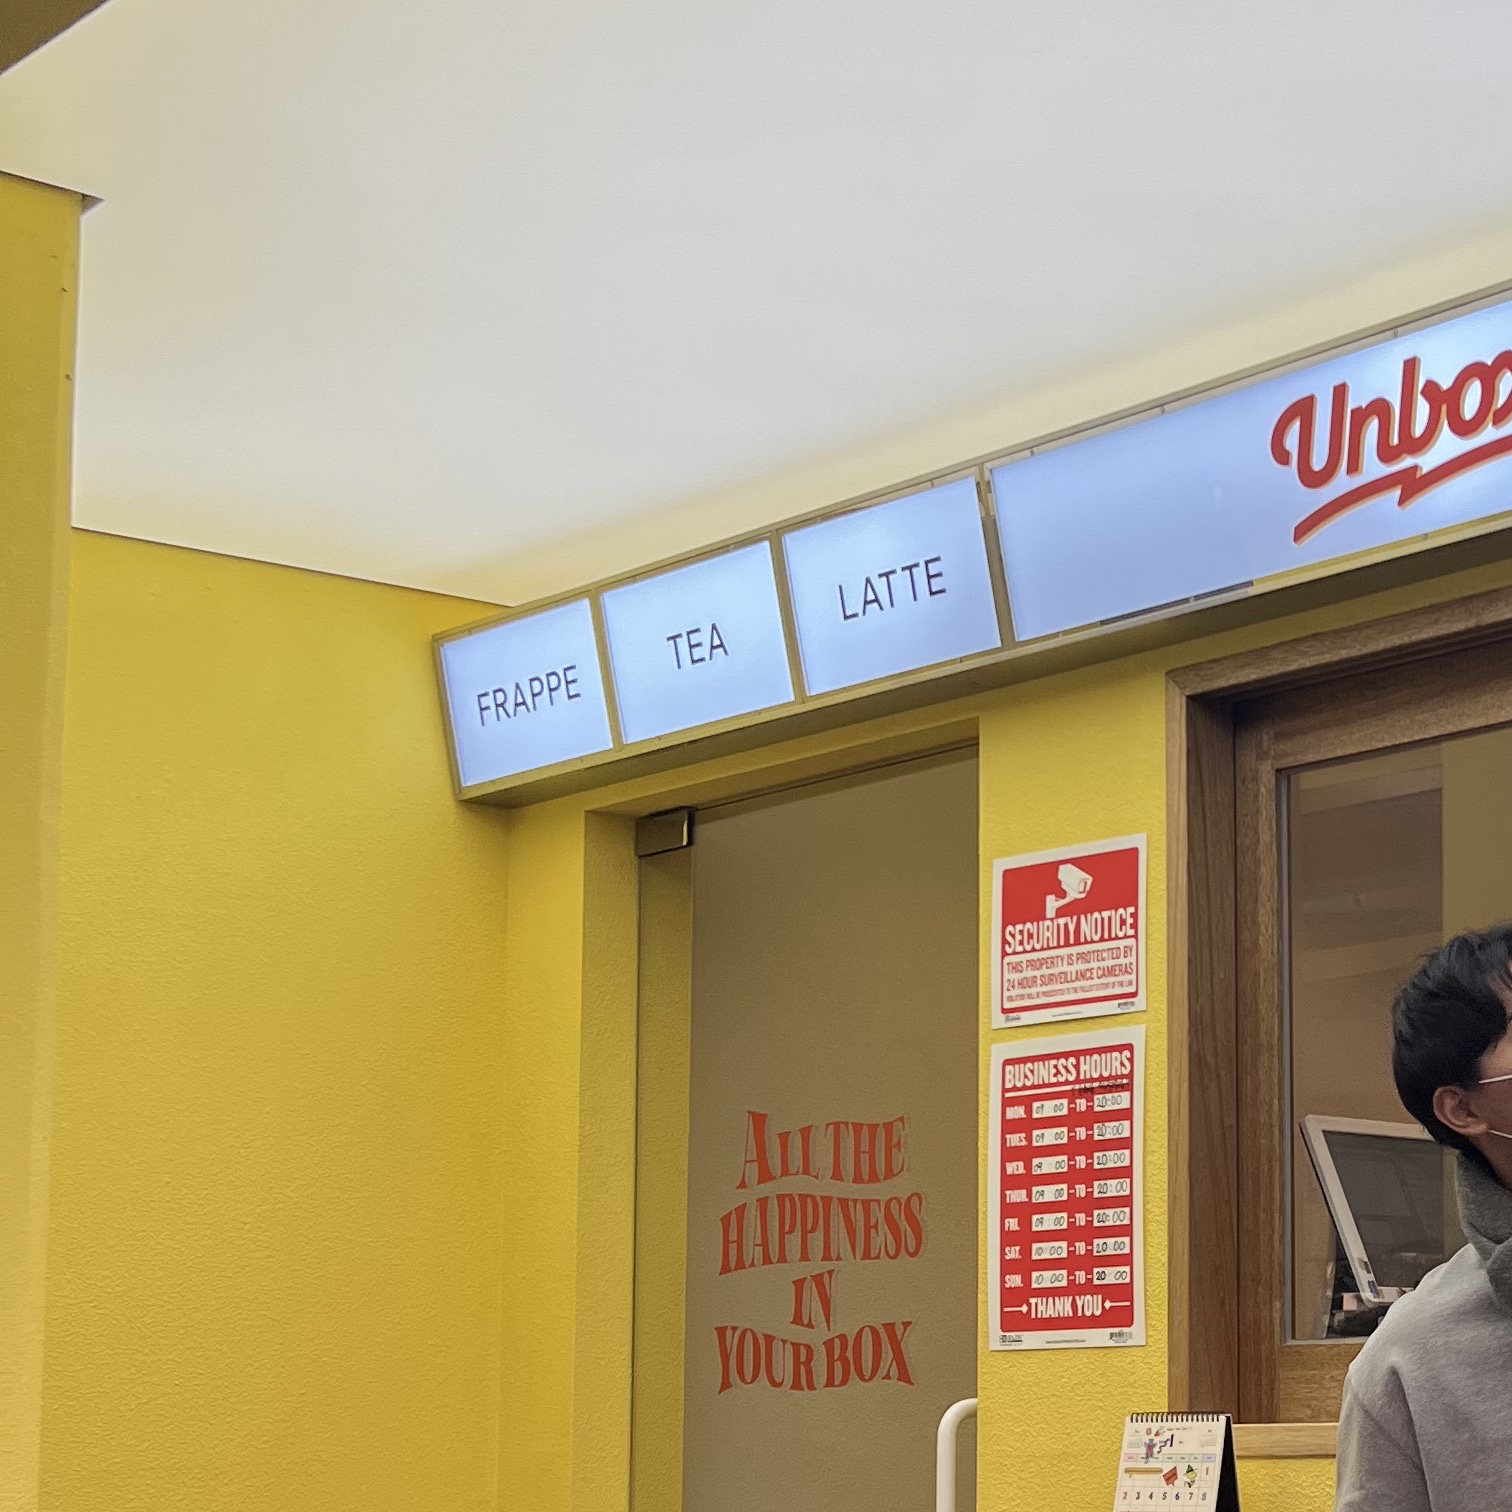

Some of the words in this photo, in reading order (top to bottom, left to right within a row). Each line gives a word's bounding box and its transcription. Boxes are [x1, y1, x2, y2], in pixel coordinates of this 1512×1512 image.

[838, 555, 947, 622] LATTE
[666, 622, 730, 671] TEA
[475, 664, 582, 727] FRAPPE
[1004, 915, 1078, 954] SECURITY
[1080, 906, 1136, 943] NOTICE
[1006, 961, 1024, 974] THIS
[1026, 955, 1066, 971] PROPERTY
[1067, 953, 1074, 966] IS
[1076, 947, 1121, 965] PROTECTED
[1123, 945, 1134, 958] BY
[1006, 979, 1016, 991] 24
[1017, 976, 1038, 990] HOUR
[1040, 967, 1095, 987] SURVEILLANCE
[1097, 962, 1134, 980] CAMERAS
[1004, 1057, 1077, 1089] BUSINESS
[1080, 1050, 1131, 1080] HOURS
[825, 1116, 906, 1184] THE
[719, 1192, 925, 1276] HAPPINESS
[790, 1268, 836, 1333] IN
[1029, 1295, 1073, 1319] THANK
[1075, 1294, 1102, 1317] YOU
[714, 1325, 817, 1395] YOUR
[823, 1320, 916, 1389] BOX
[1122, 1491, 1128, 1500] 2
[1135, 1491, 1141, 1501] 3
[1148, 1491, 1154, 1501] 4
[1162, 1491, 1168, 1501] 5
[1175, 1491, 1180, 1501] 6
[1188, 1491, 1194, 1501] 7
